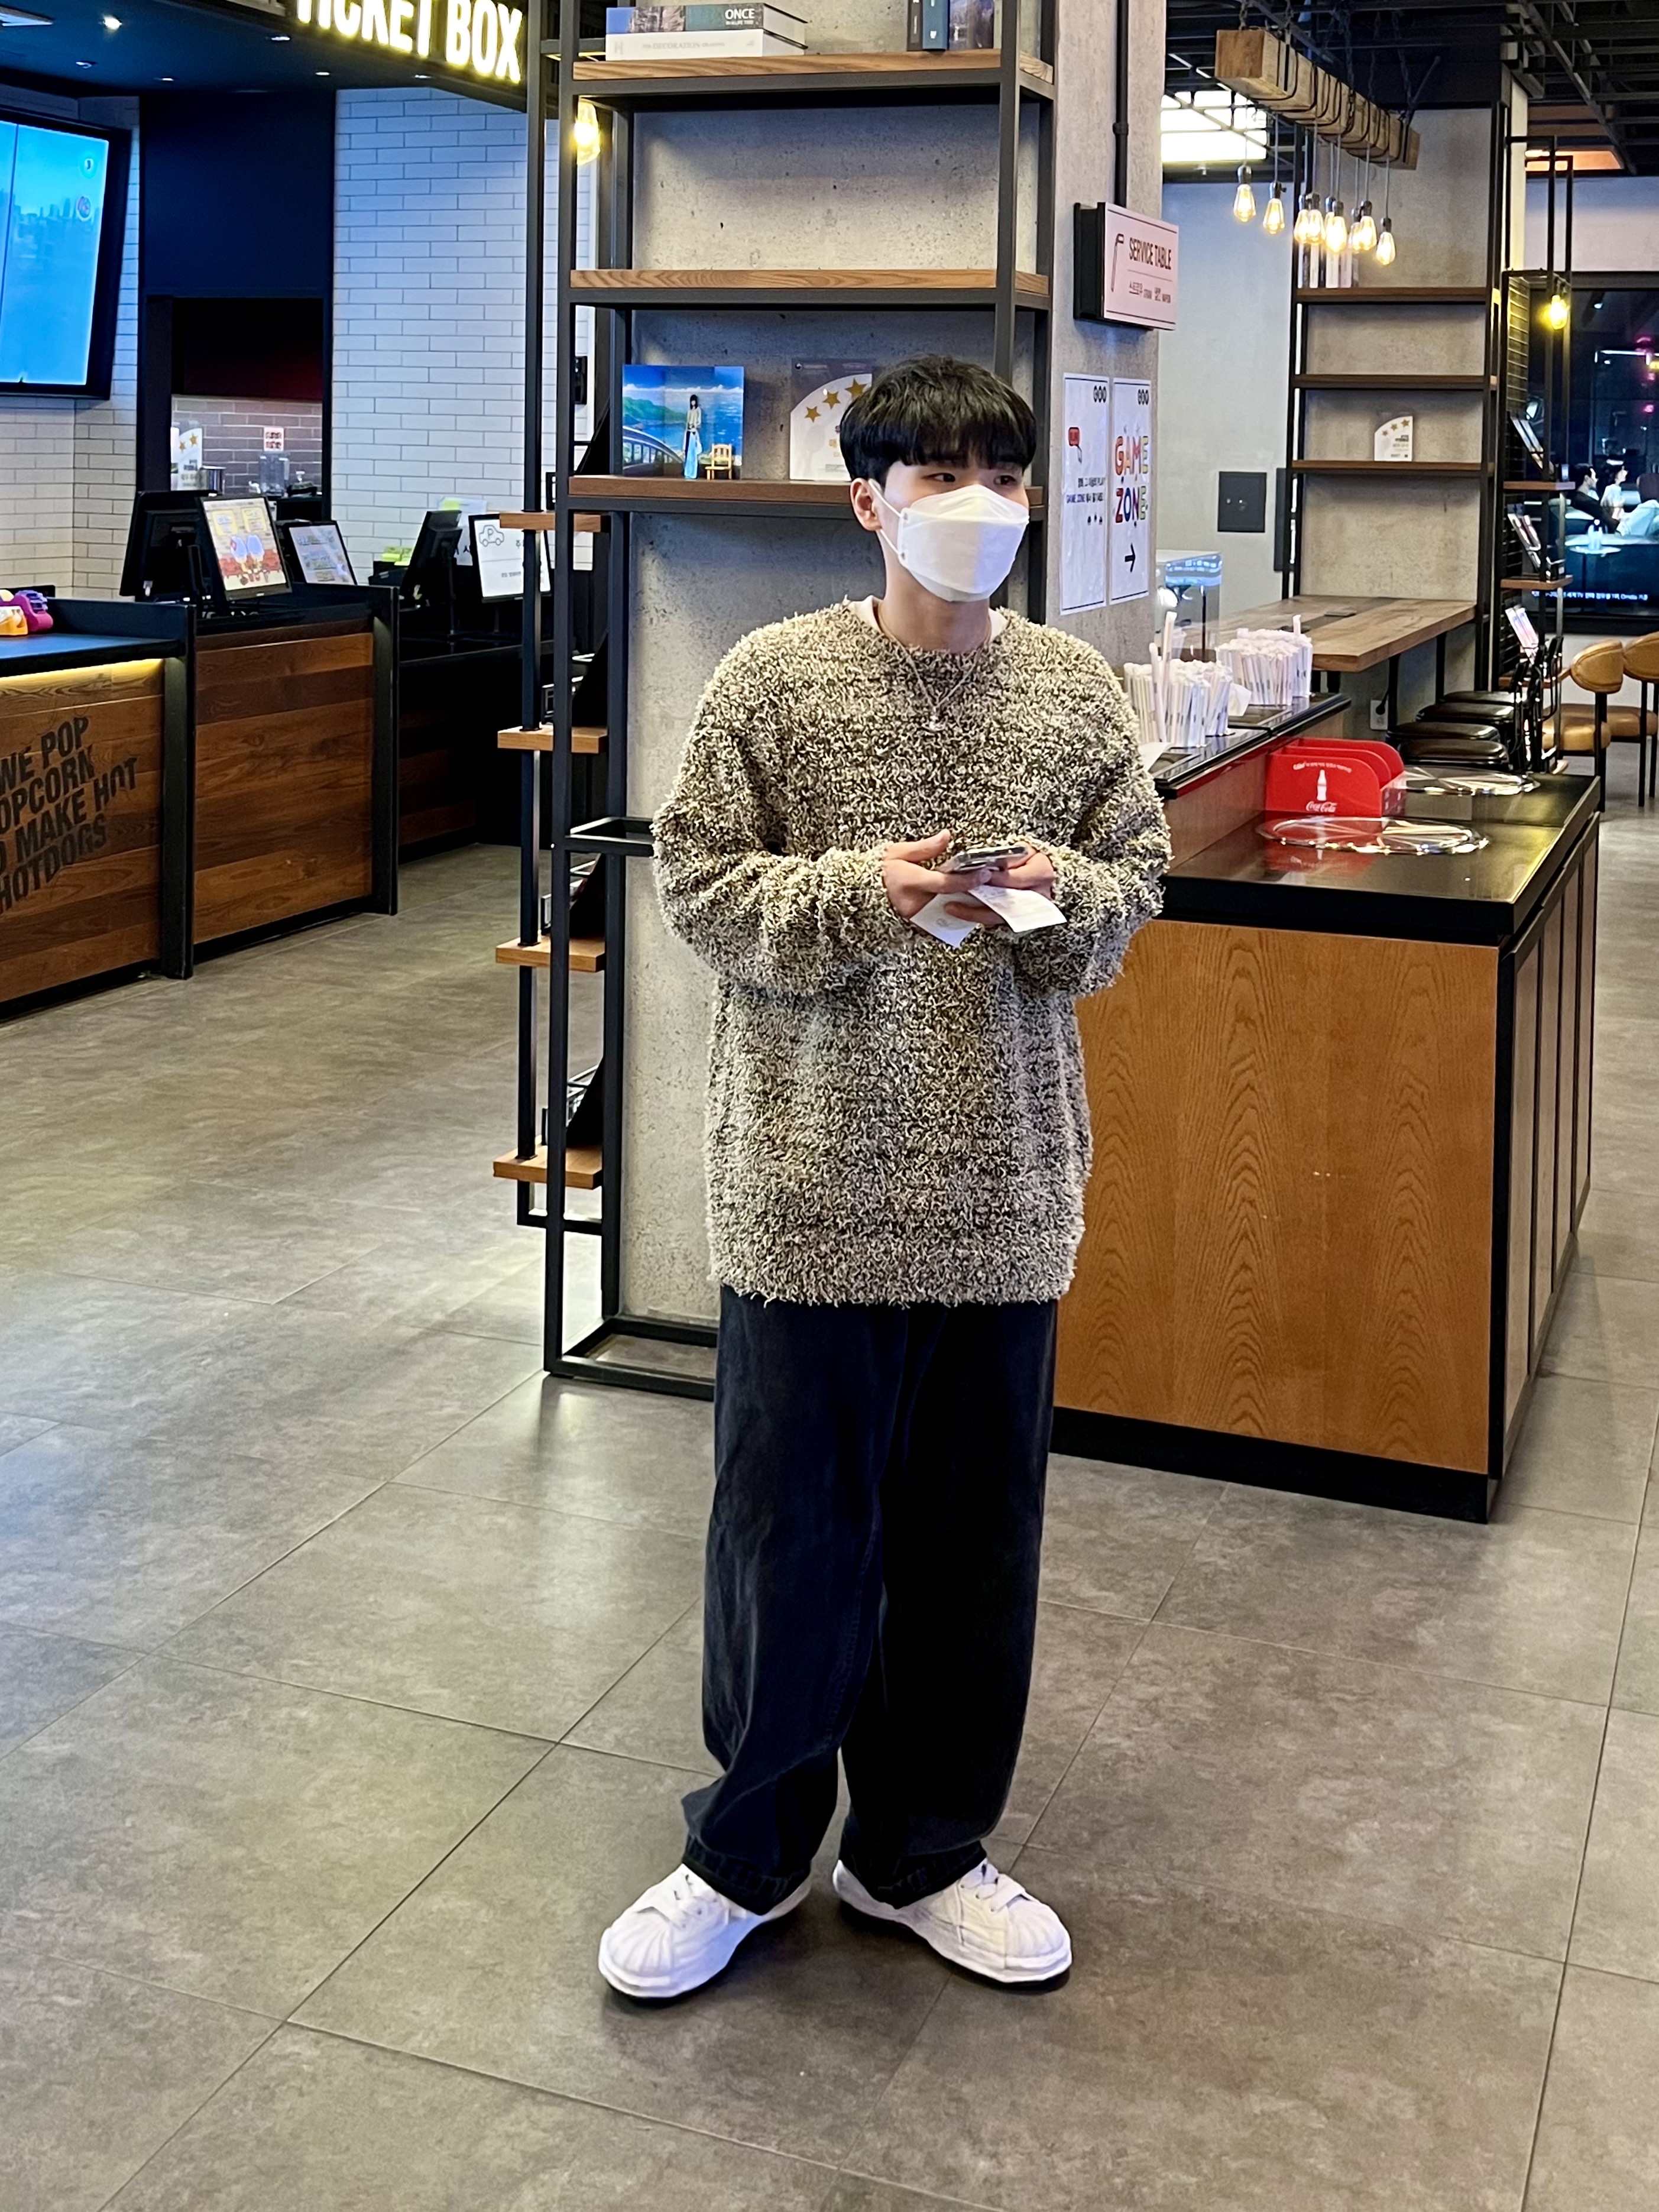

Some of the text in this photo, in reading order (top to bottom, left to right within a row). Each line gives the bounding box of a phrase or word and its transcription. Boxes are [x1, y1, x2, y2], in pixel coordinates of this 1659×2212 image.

[725, 8, 755, 20] ONCE
[446, 0, 523, 84] BOX
[1129, 237, 1172, 270] SERVICE TABLE
[1115, 435, 1149, 475] GAME
[1115, 485, 1147, 523] ZONE
[41, 717, 89, 770] POP
[15, 788, 87, 863] MAKE
[93, 757, 137, 812] HOT
